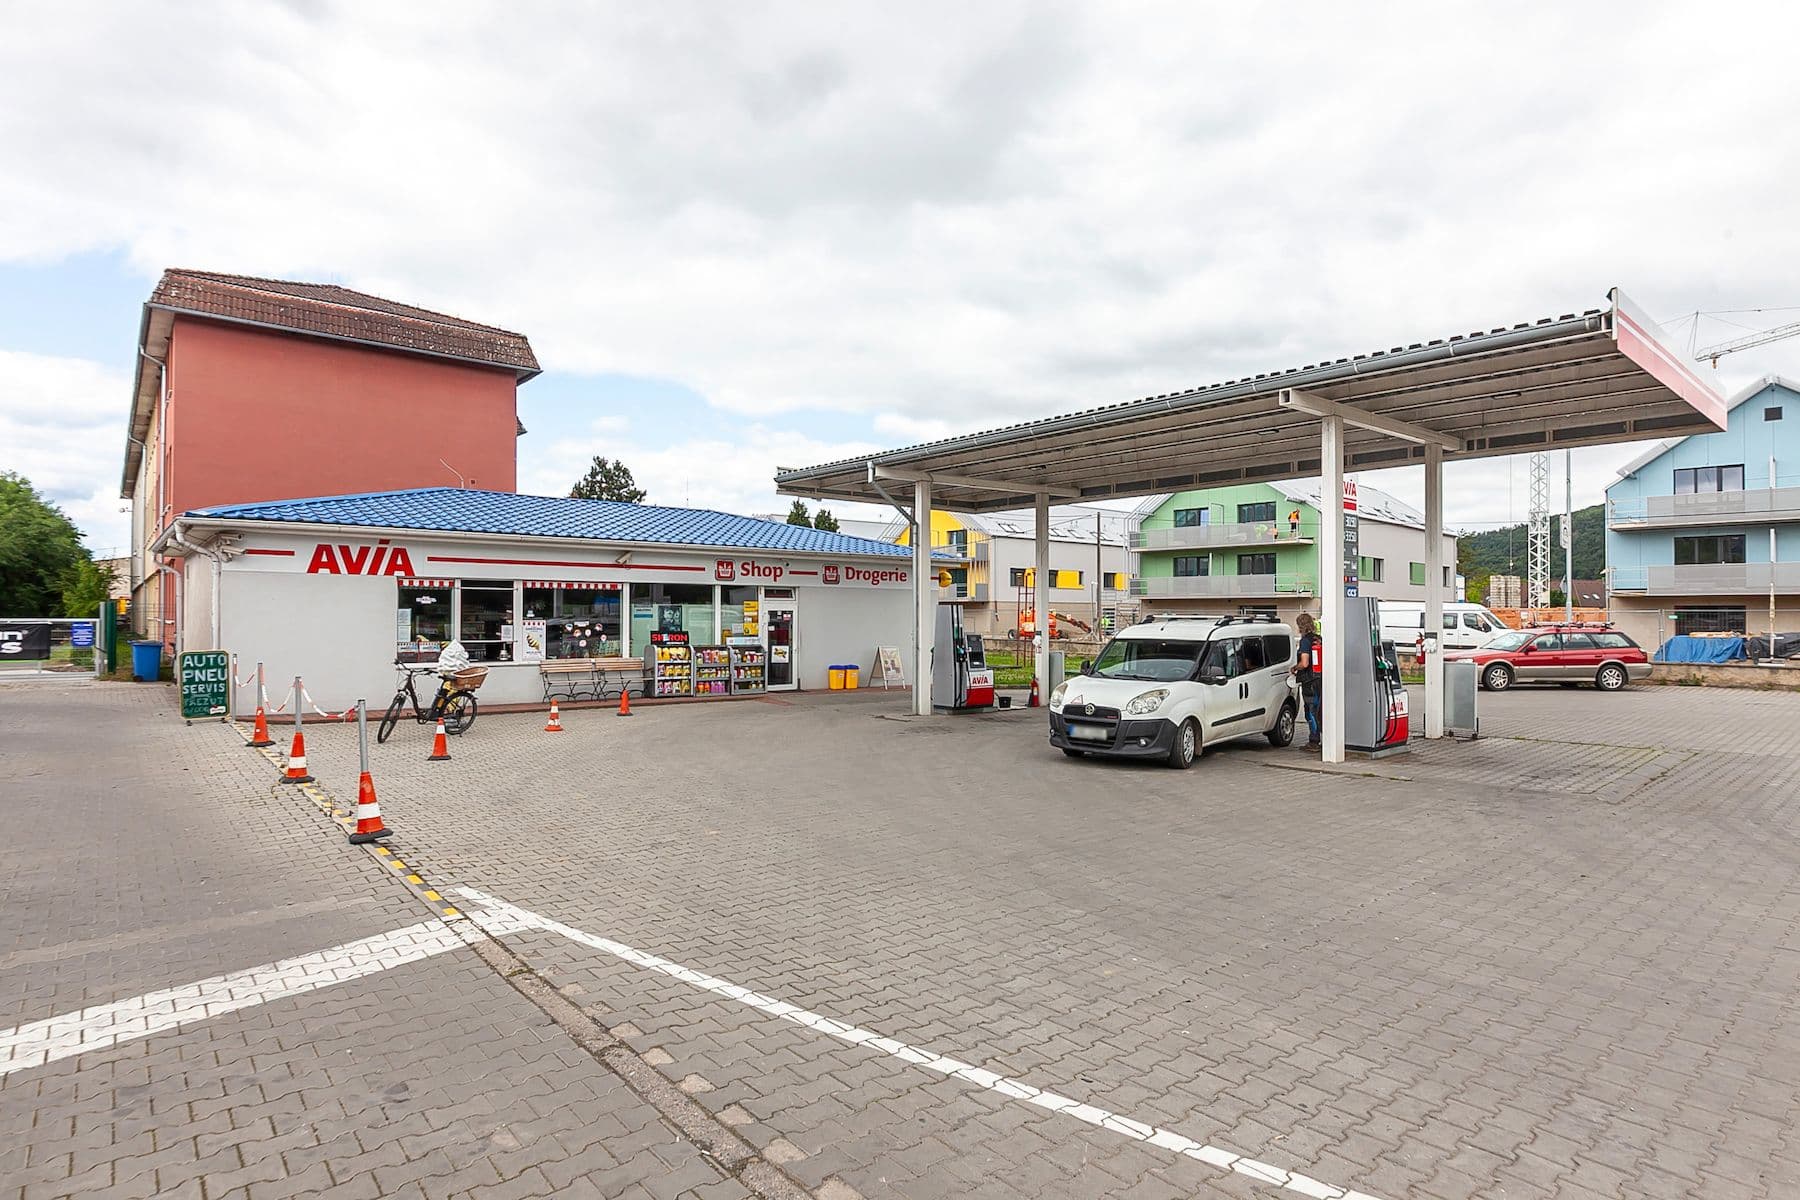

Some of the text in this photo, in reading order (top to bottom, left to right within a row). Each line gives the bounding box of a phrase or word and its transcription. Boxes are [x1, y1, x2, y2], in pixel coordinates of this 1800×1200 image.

[1343, 479, 1357, 497] VIA
[306, 538, 416, 577] AVIA
[740, 561, 784, 583] Shop
[844, 567, 908, 586] Drogerie
[183, 654, 228, 668] AUTO
[182, 668, 228, 682] PNEU
[182, 683, 226, 695] SERVIS
